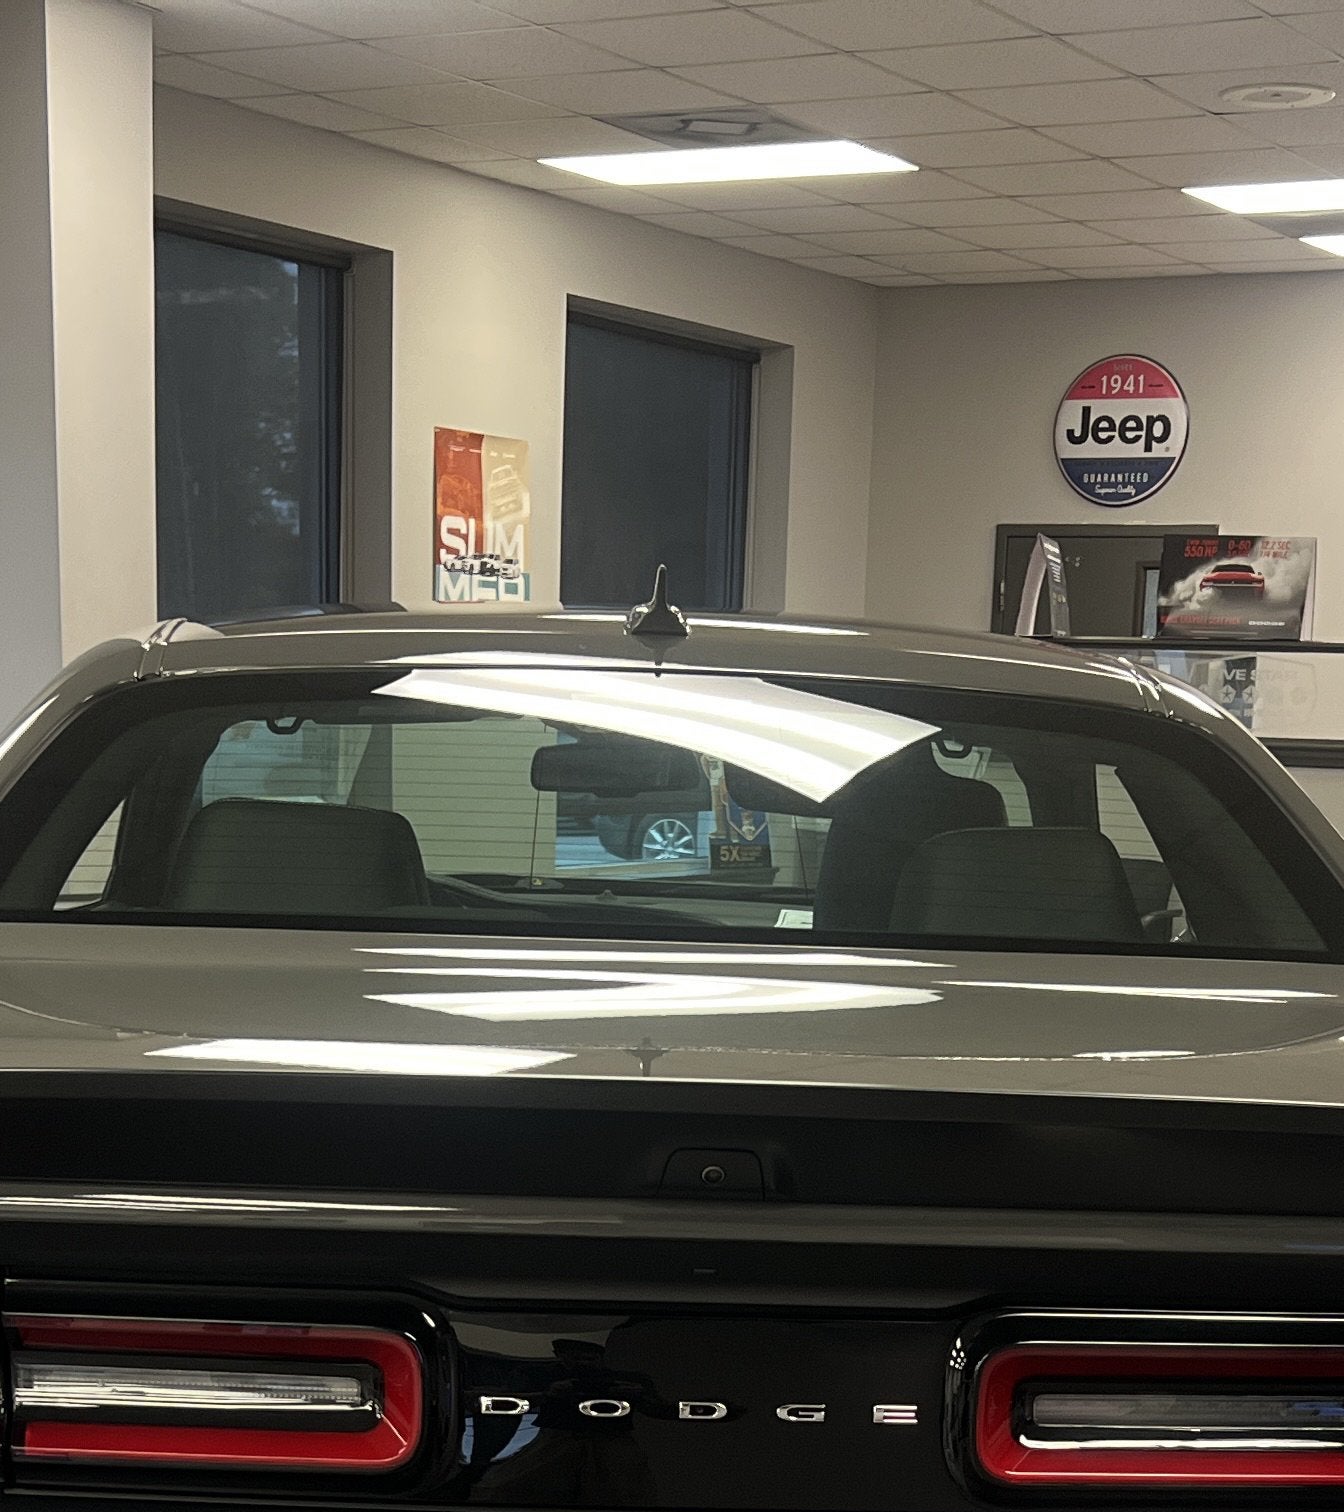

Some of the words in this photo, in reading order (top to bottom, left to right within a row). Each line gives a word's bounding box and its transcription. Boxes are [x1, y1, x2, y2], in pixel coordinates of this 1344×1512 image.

[1100, 374, 1145, 395] 1941
[1066, 405, 1172, 453] Jeep
[1083, 472, 1149, 483] GUARANTEED
[1184, 546, 1204, 558] 550
[1228, 539, 1251, 550] 0-60
[480, 1396, 918, 1424] DODGE
